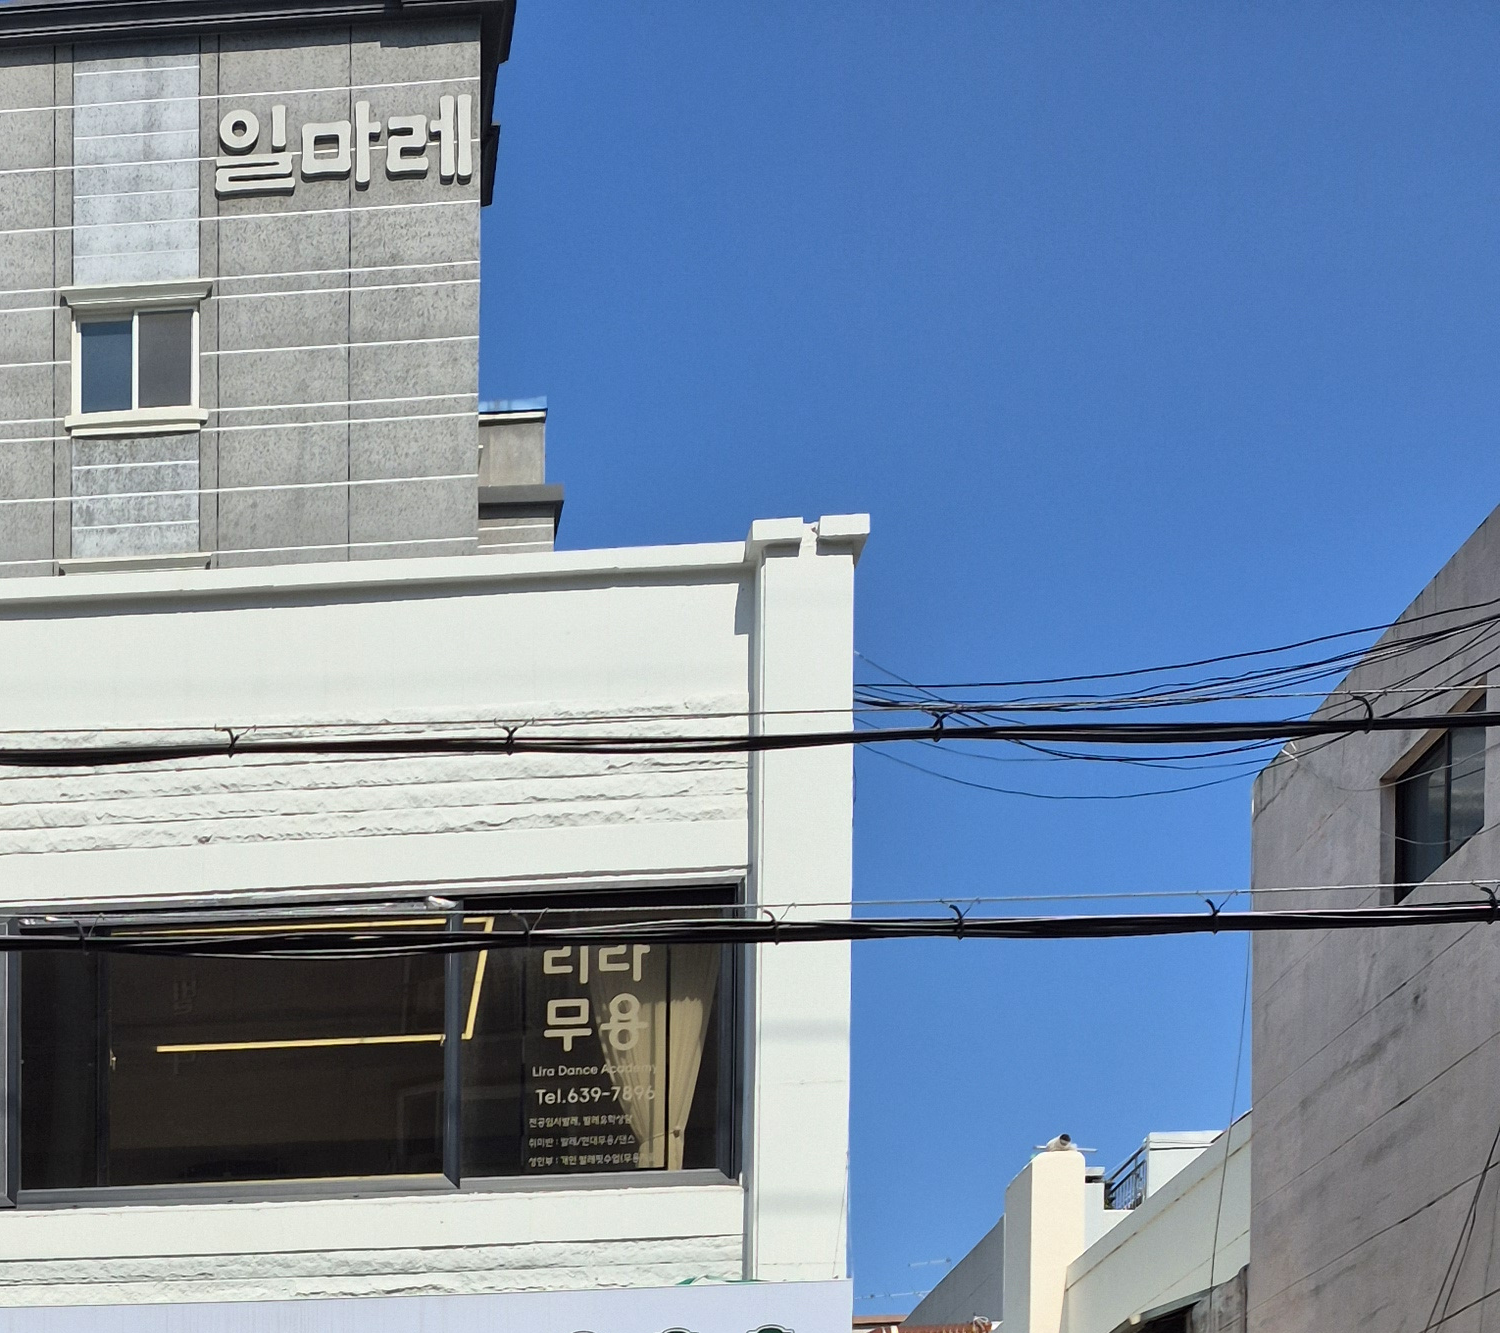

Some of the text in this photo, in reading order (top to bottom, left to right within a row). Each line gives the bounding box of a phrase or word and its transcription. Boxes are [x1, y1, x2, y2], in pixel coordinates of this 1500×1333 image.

[215, 94, 472, 196] 일마레
[544, 993, 649, 1052] 무용
[532, 1066, 555, 1077] Lira
[558, 1065, 598, 1076] Dance
